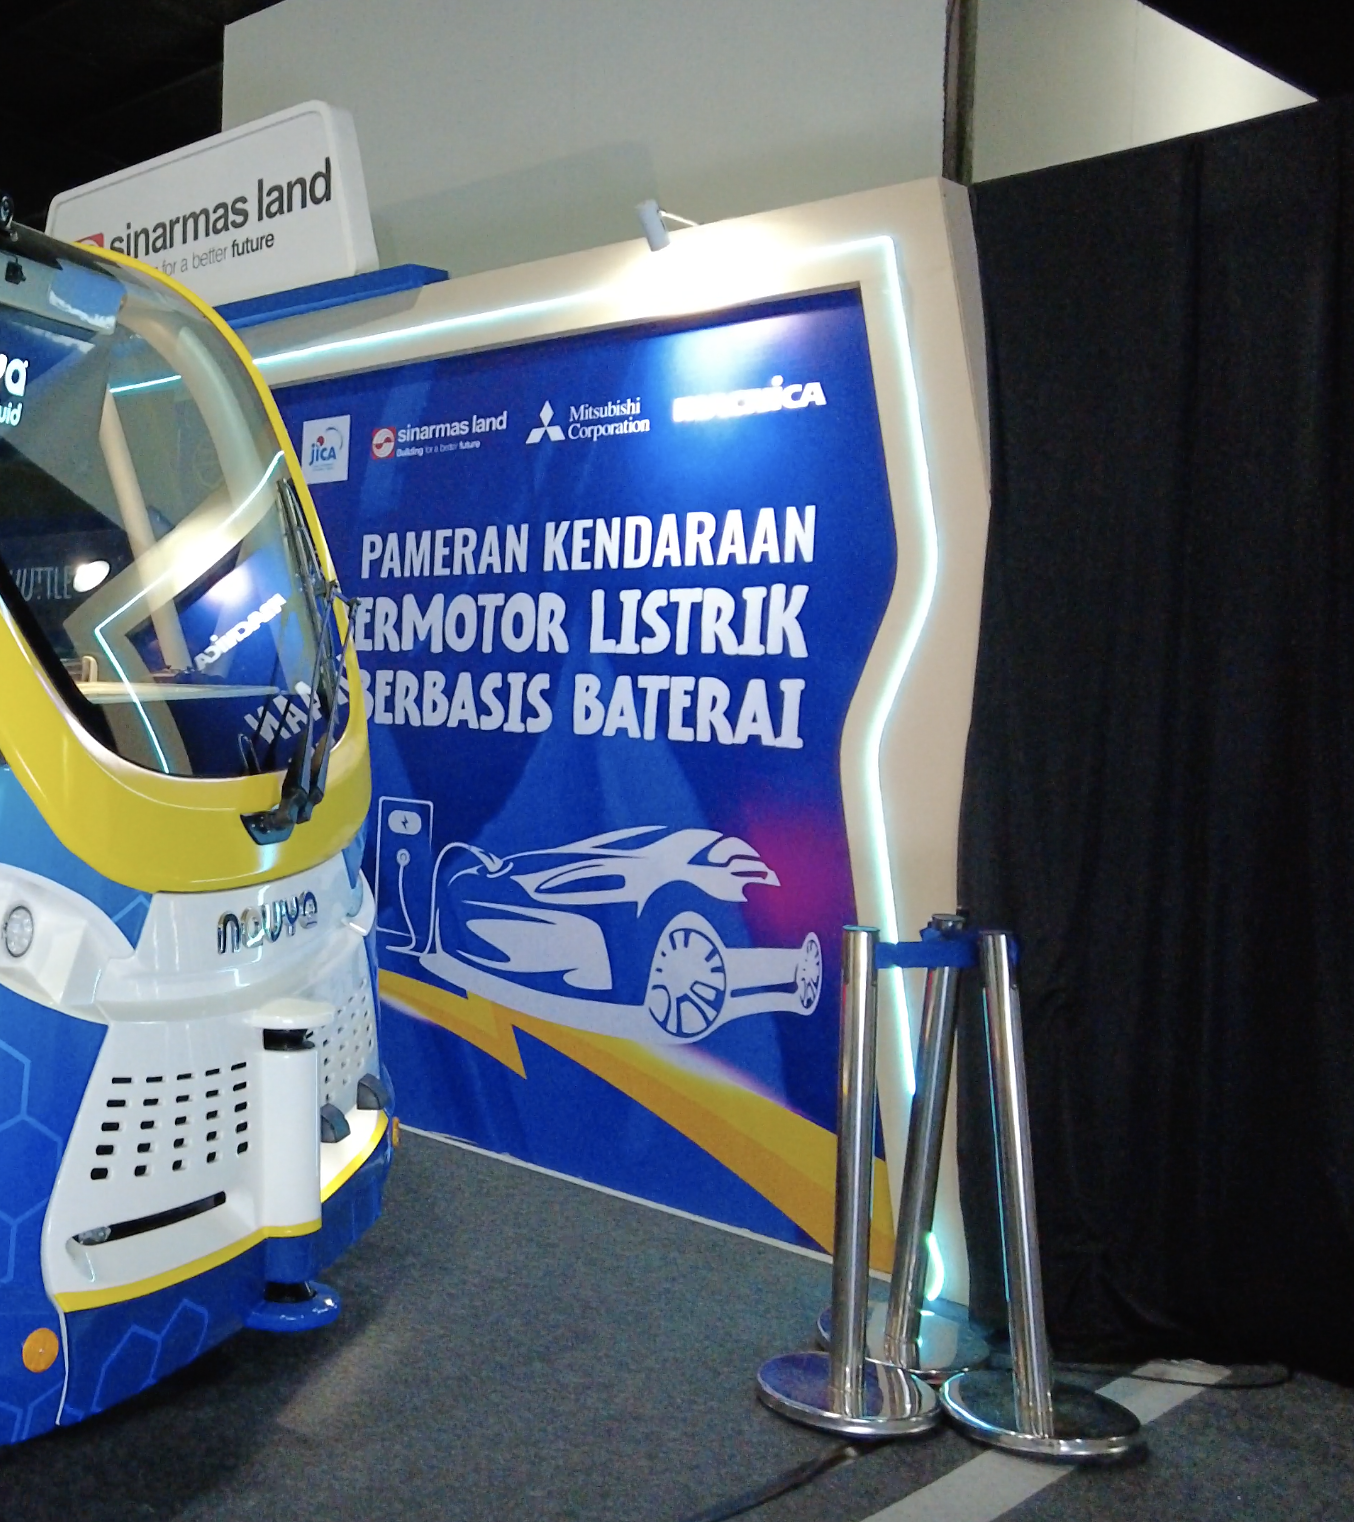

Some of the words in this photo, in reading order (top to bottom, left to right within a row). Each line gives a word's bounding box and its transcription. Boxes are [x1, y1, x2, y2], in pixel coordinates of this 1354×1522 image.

[109, 194, 250, 259] sinarmas
[257, 156, 332, 222] land
[180, 257, 188, 273] a
[192, 246, 228, 270] better
[231, 232, 275, 259] future
[397, 423, 470, 443] sinarmas
[471, 410, 509, 435] land
[567, 417, 651, 442] Corporation
[569, 397, 641, 423] Mitsubishi
[360, 523, 530, 580] PAMERAN
[542, 505, 817, 573] KENDARAAN
[353, 592, 570, 654] ERMOTOR
[590, 583, 810, 659] LISTRIK
[358, 668, 554, 734] BERBASIS
[572, 673, 806, 750] BATERAI
